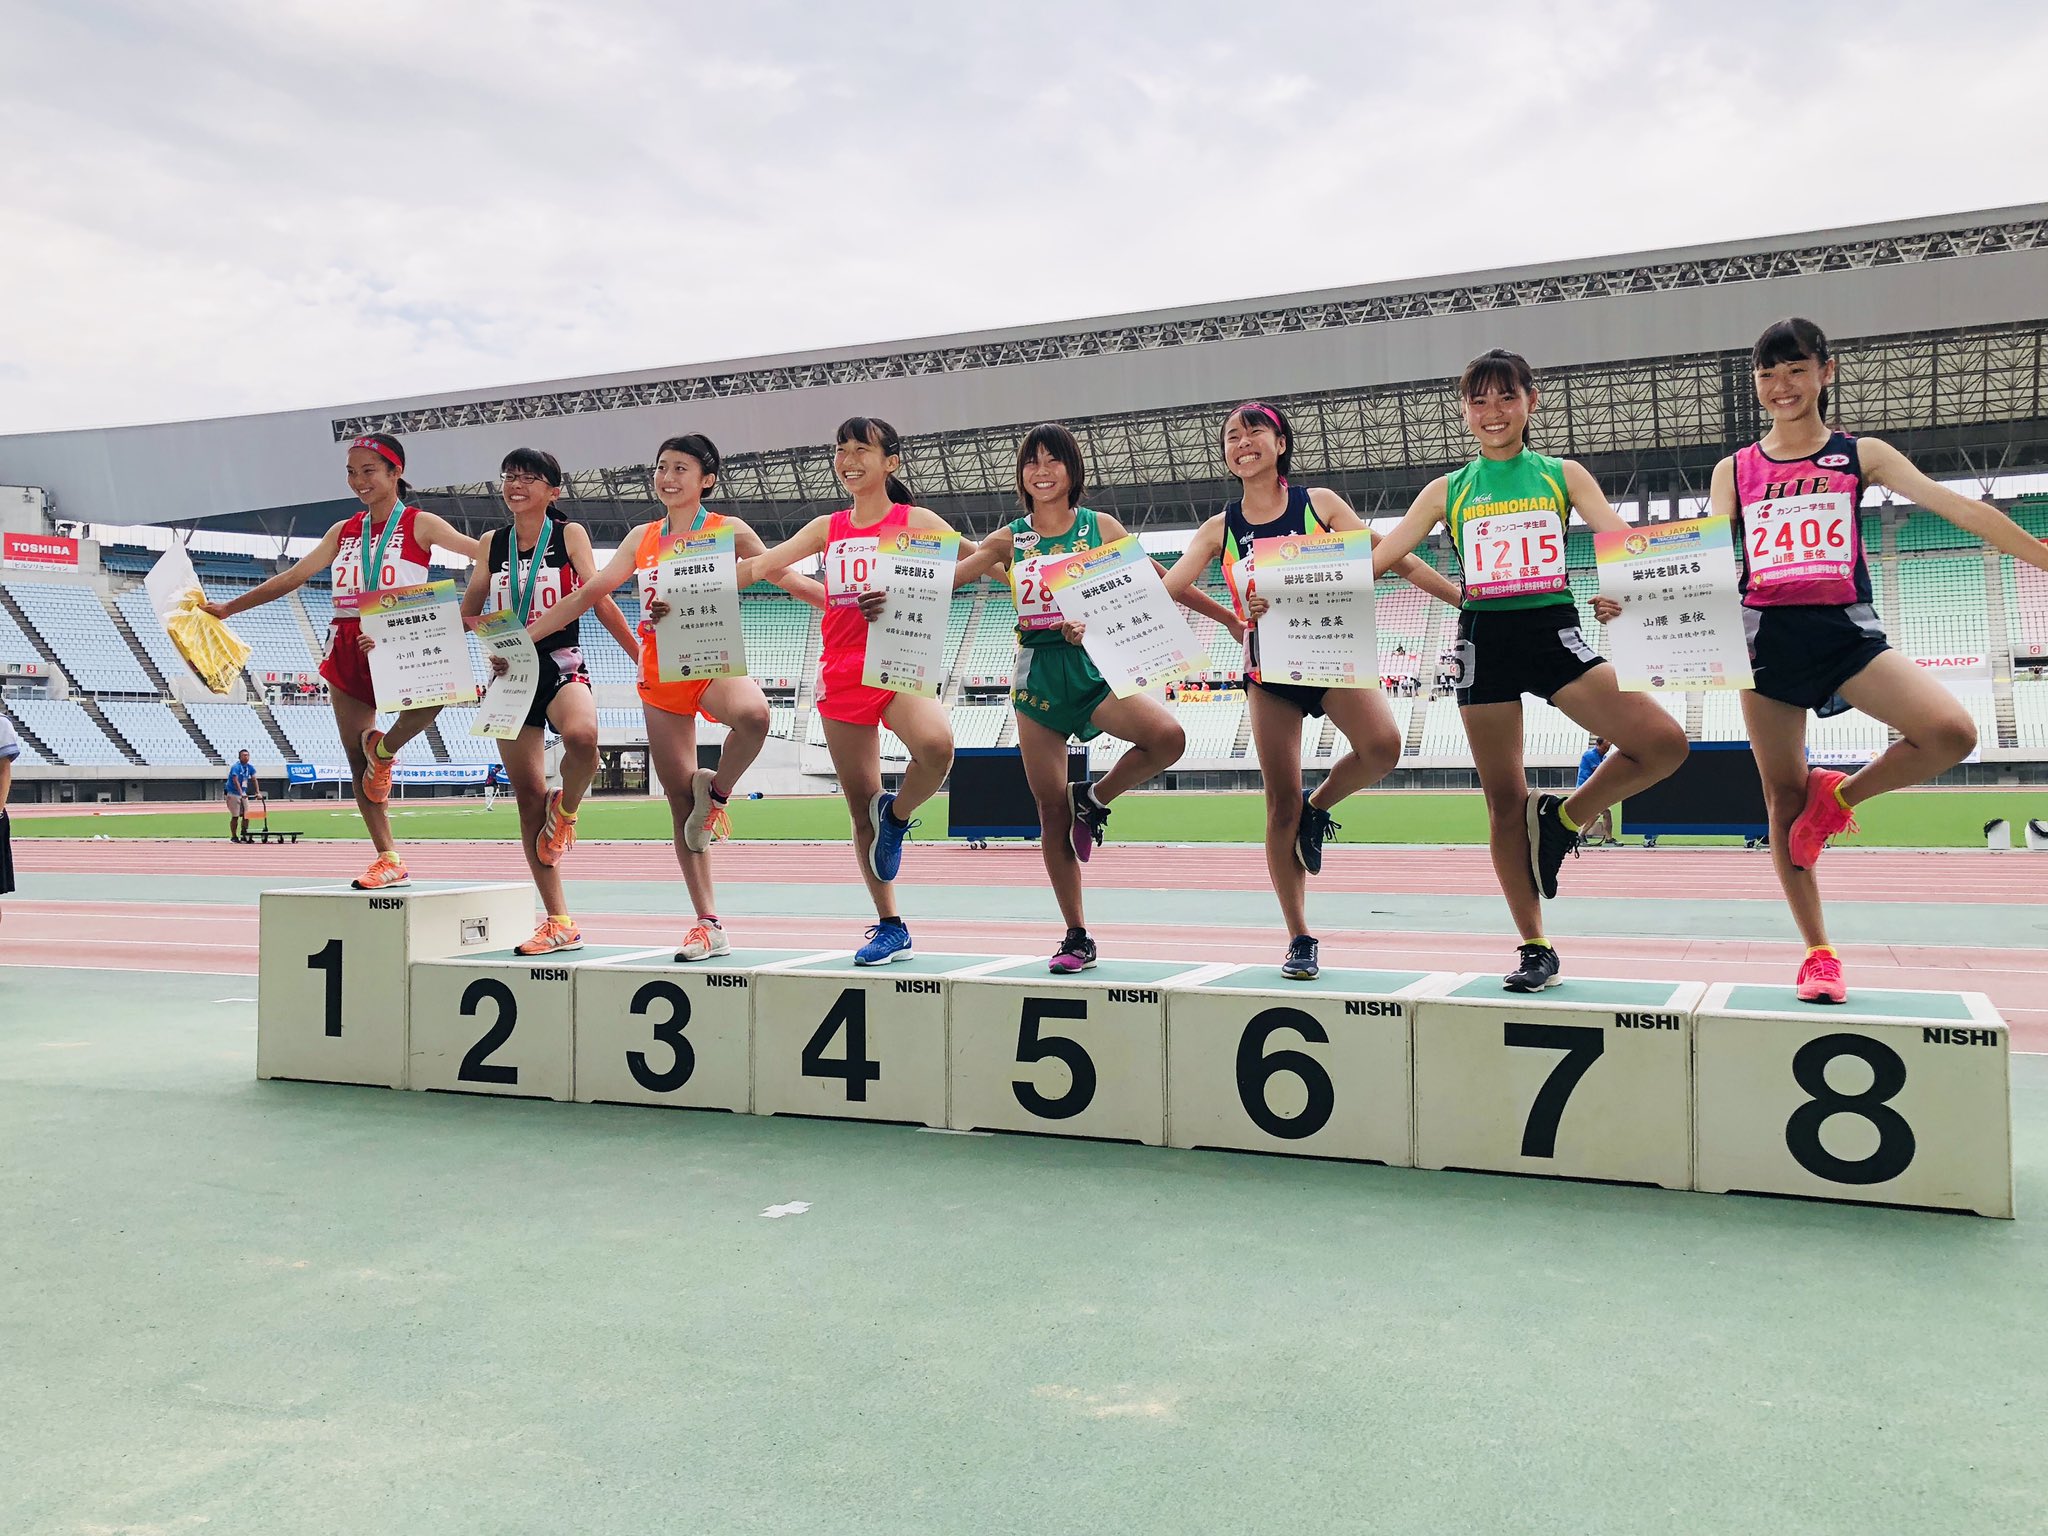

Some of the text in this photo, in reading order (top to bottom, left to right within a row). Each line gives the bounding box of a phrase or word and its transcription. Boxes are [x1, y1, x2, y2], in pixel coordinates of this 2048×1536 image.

[1764, 476, 1830, 500] HIE
[1462, 496, 1558, 521] NISHINOHARA
[1777, 503, 1835, 515] カンコー学生服
[1495, 520, 1547, 533] カンコー学生服
[1668, 525, 1699, 535] JAPAN
[1318, 537, 1344, 545] JAPAN
[1752, 518, 1844, 558] 2406
[11, 542, 70, 555] TOSHIBA
[1096, 547, 1117, 558] JAPAN
[1474, 534, 1558, 571] 1215
[1772, 549, 1826, 565] 山腰 亜依
[335, 565, 396, 588] 210
[1284, 571, 1343, 585] 栄光を讃える
[1491, 566, 1540, 580] 鈴木 優菜
[1632, 562, 1701, 581] 栄光を讃える
[679, 607, 695, 617] 上西
[1643, 611, 1706, 627] 山腰 亜依
[1106, 622, 1125, 635] 山本
[1289, 616, 1344, 627] 鈴木 優菜
[2030, 646, 2040, 654] G
[1915, 657, 1979, 668] SHARP
[1067, 746, 1085, 755] ISHI
[307, 939, 344, 1037] 1
[706, 975, 747, 988] NISHI
[896, 981, 941, 994] NISHI
[1108, 989, 1158, 1004] NISHI
[1345, 1001, 1402, 1017] NISHI
[1616, 1013, 1680, 1031] NISHI
[458, 978, 519, 1084] 2
[626, 980, 695, 1092] 3
[1923, 1027, 1998, 1048] NISHI
[802, 988, 880, 1102] 4
[1012, 997, 1097, 1119] 5
[1236, 1007, 1335, 1139] 6
[1504, 1022, 1605, 1158] 7
[1785, 1033, 1916, 1184] 8
